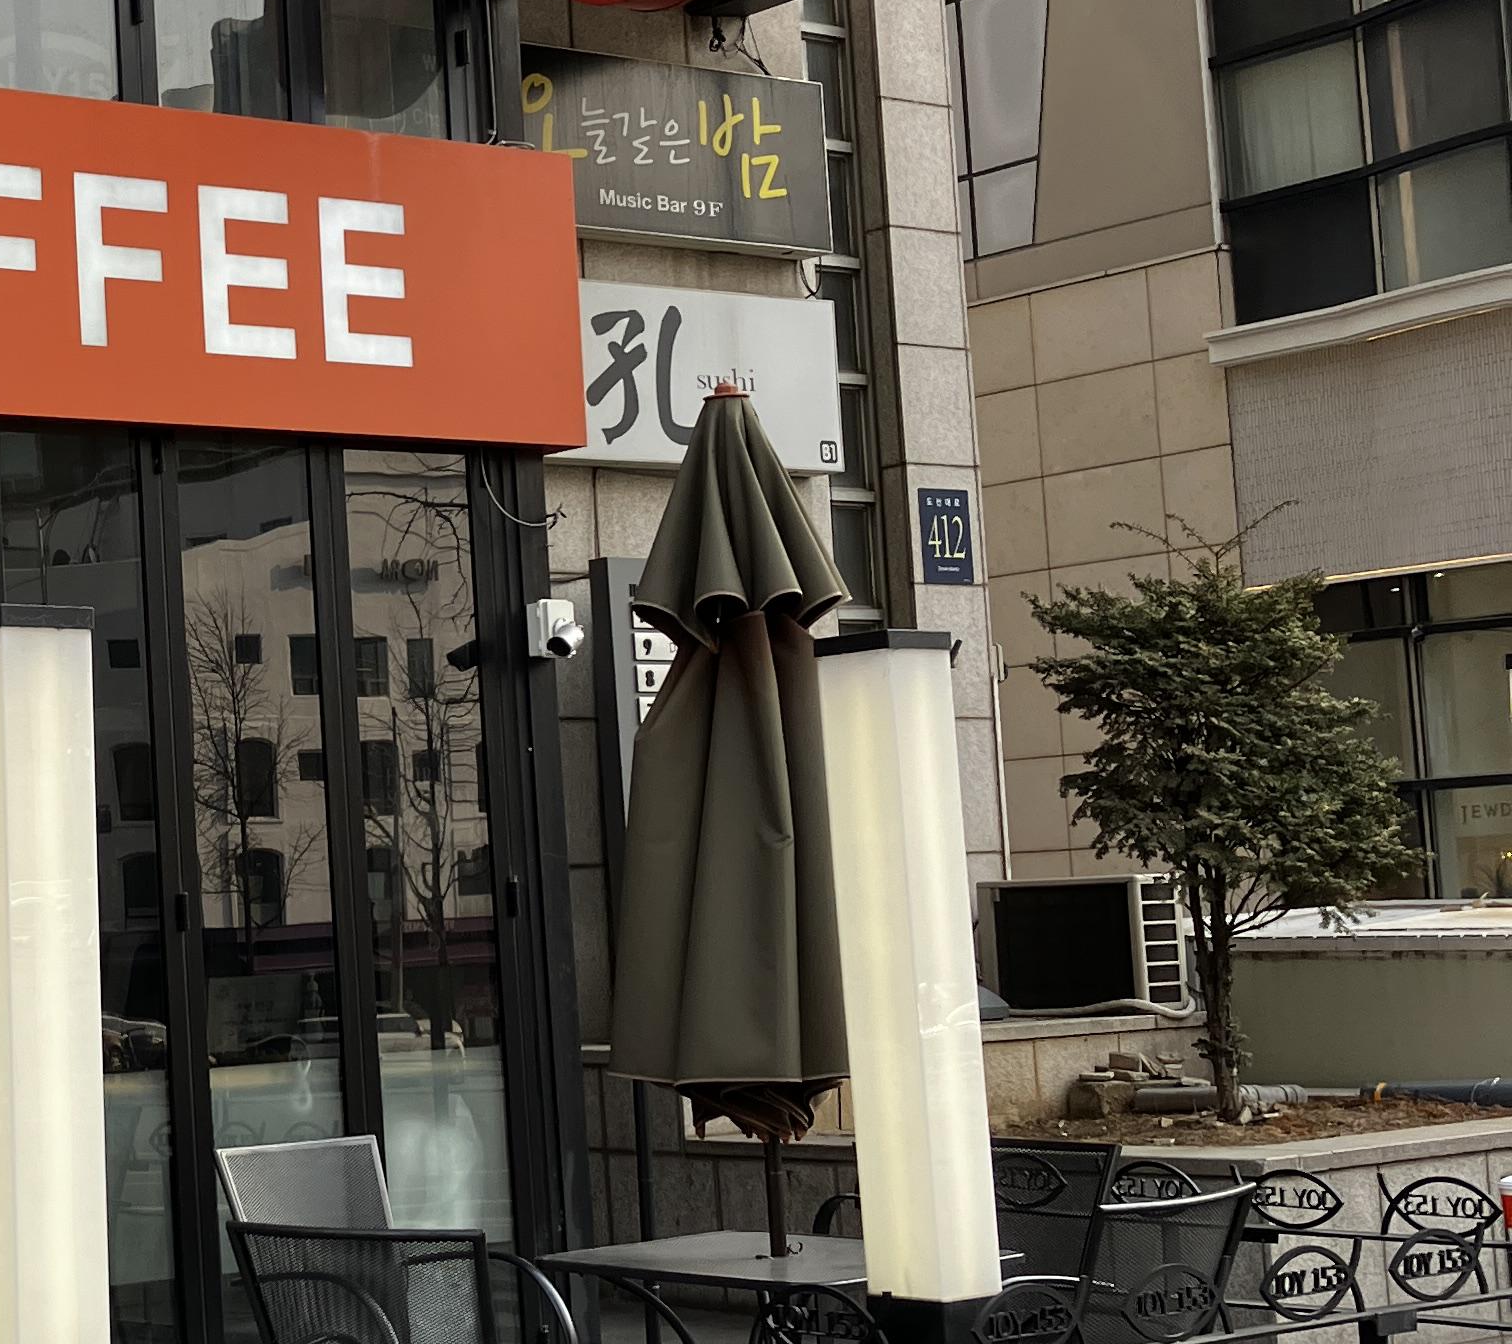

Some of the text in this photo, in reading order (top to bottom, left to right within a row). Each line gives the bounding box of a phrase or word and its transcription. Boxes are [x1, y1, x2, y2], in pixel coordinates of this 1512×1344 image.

[599, 188, 652, 210] Music
[657, 194, 686, 214] Bar
[927, 514, 967, 559] 412
[642, 638, 653, 656] 9
[644, 669, 656, 687] 8
